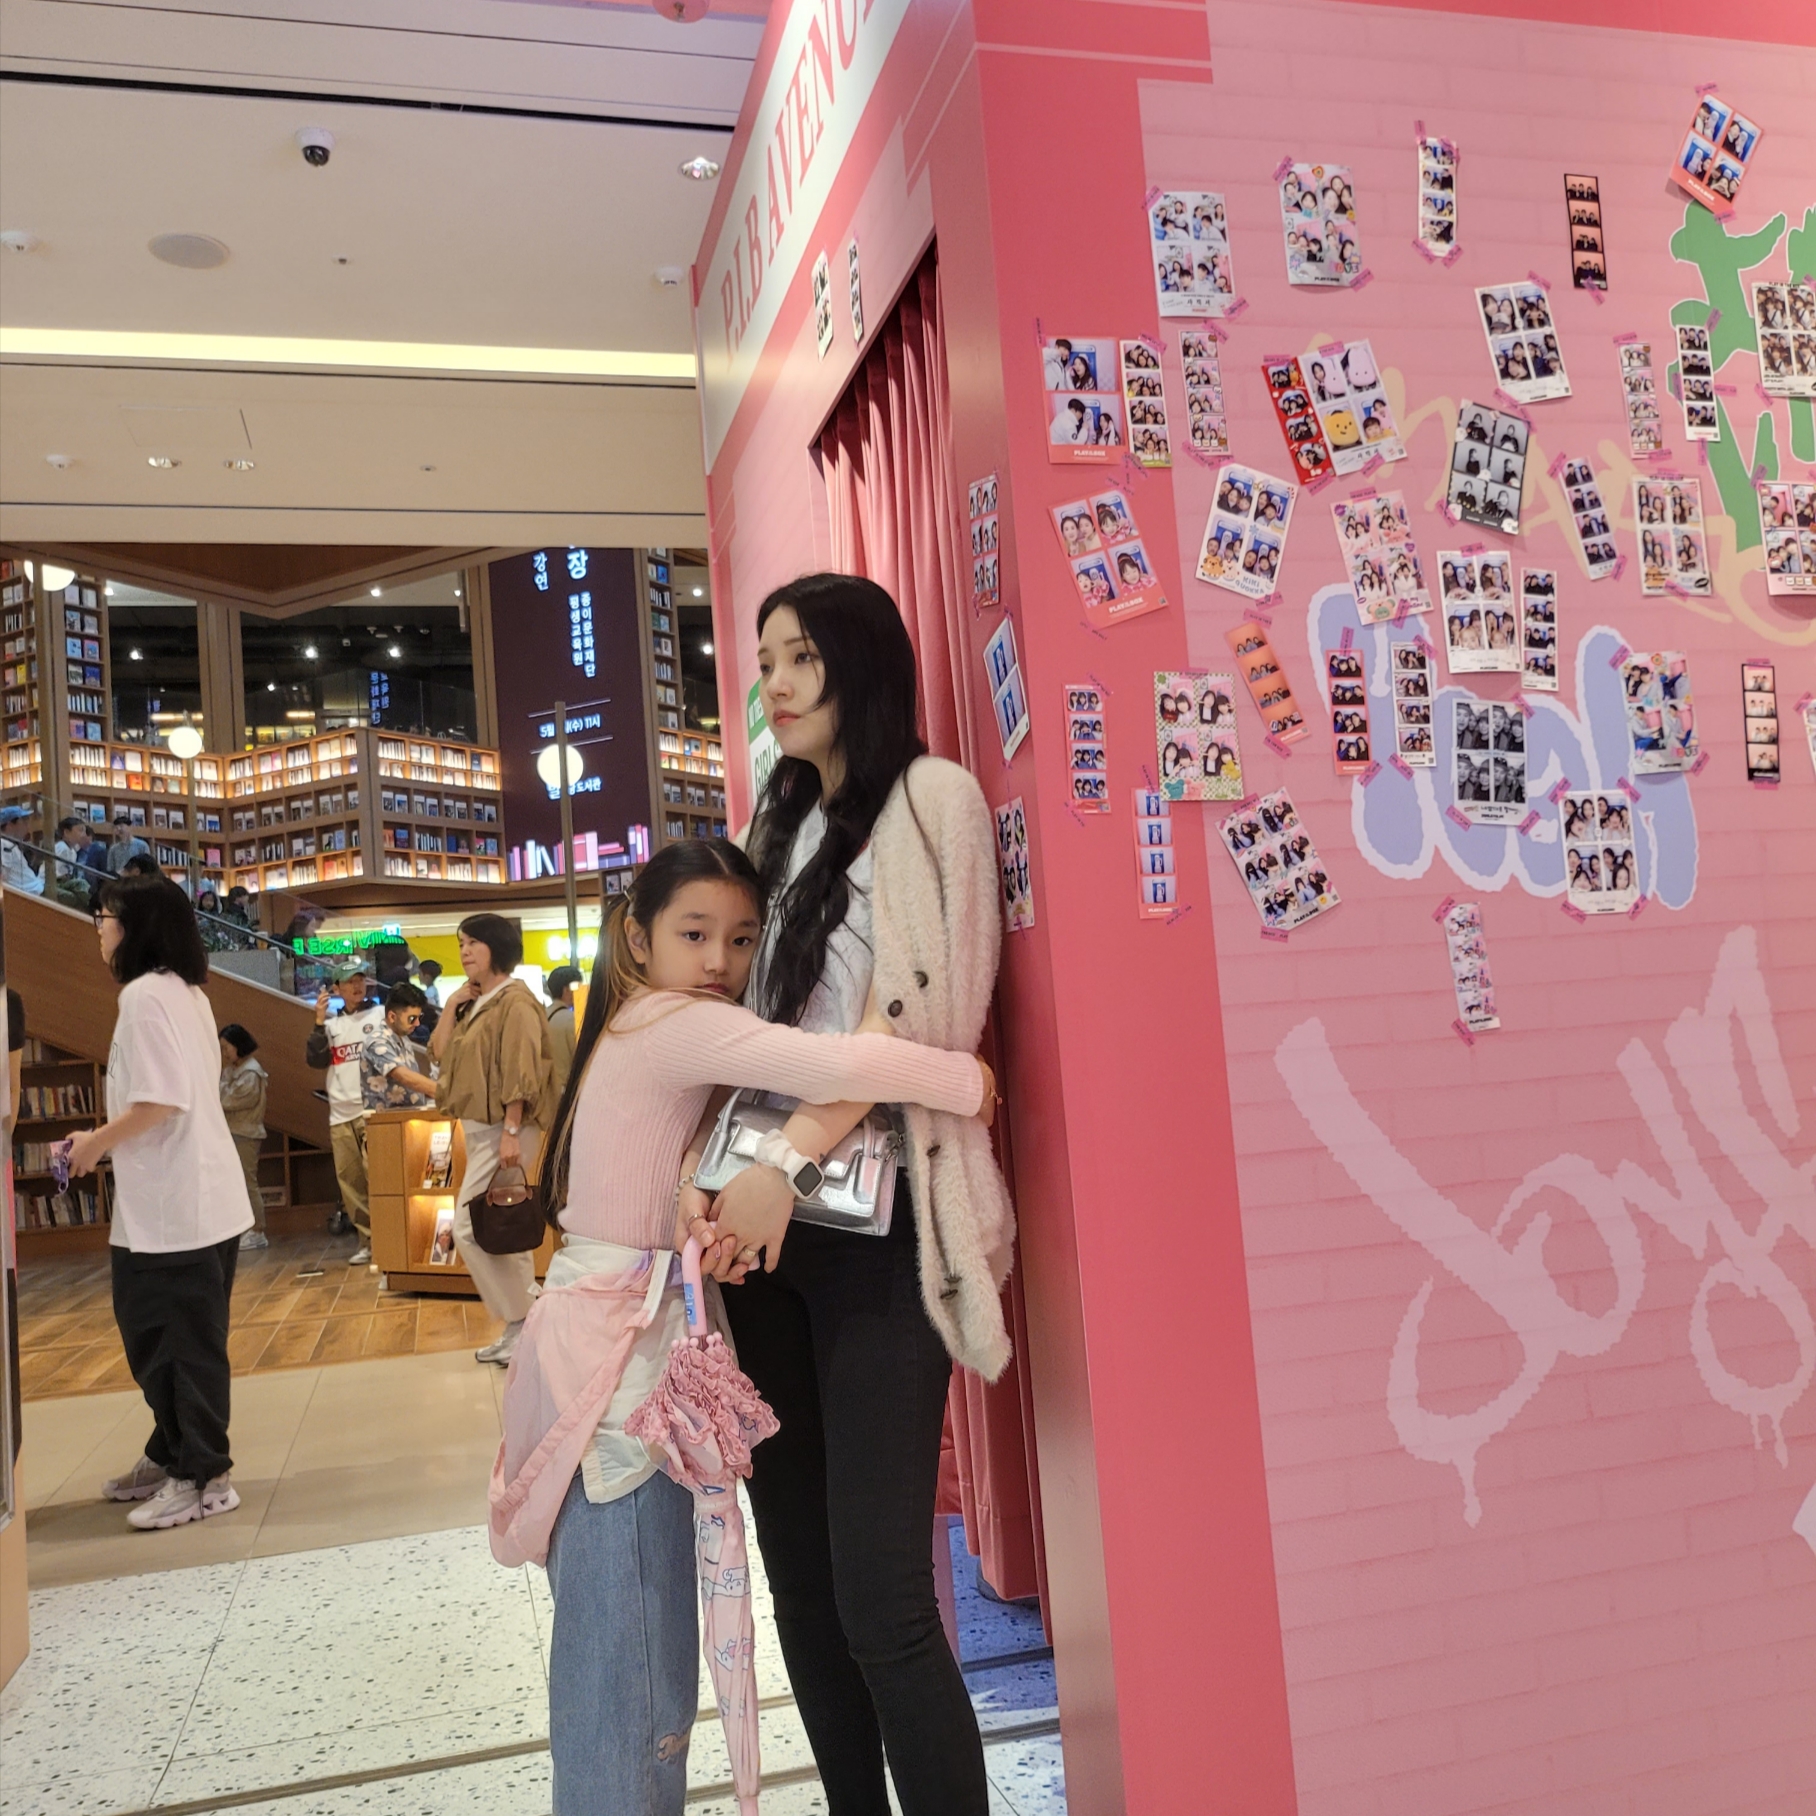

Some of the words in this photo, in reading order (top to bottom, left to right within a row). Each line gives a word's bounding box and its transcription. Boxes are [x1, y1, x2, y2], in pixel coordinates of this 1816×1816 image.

[767, 0, 877, 269] AVENU
[533, 551, 549, 591] 강연
[567, 546, 589, 579] 장
